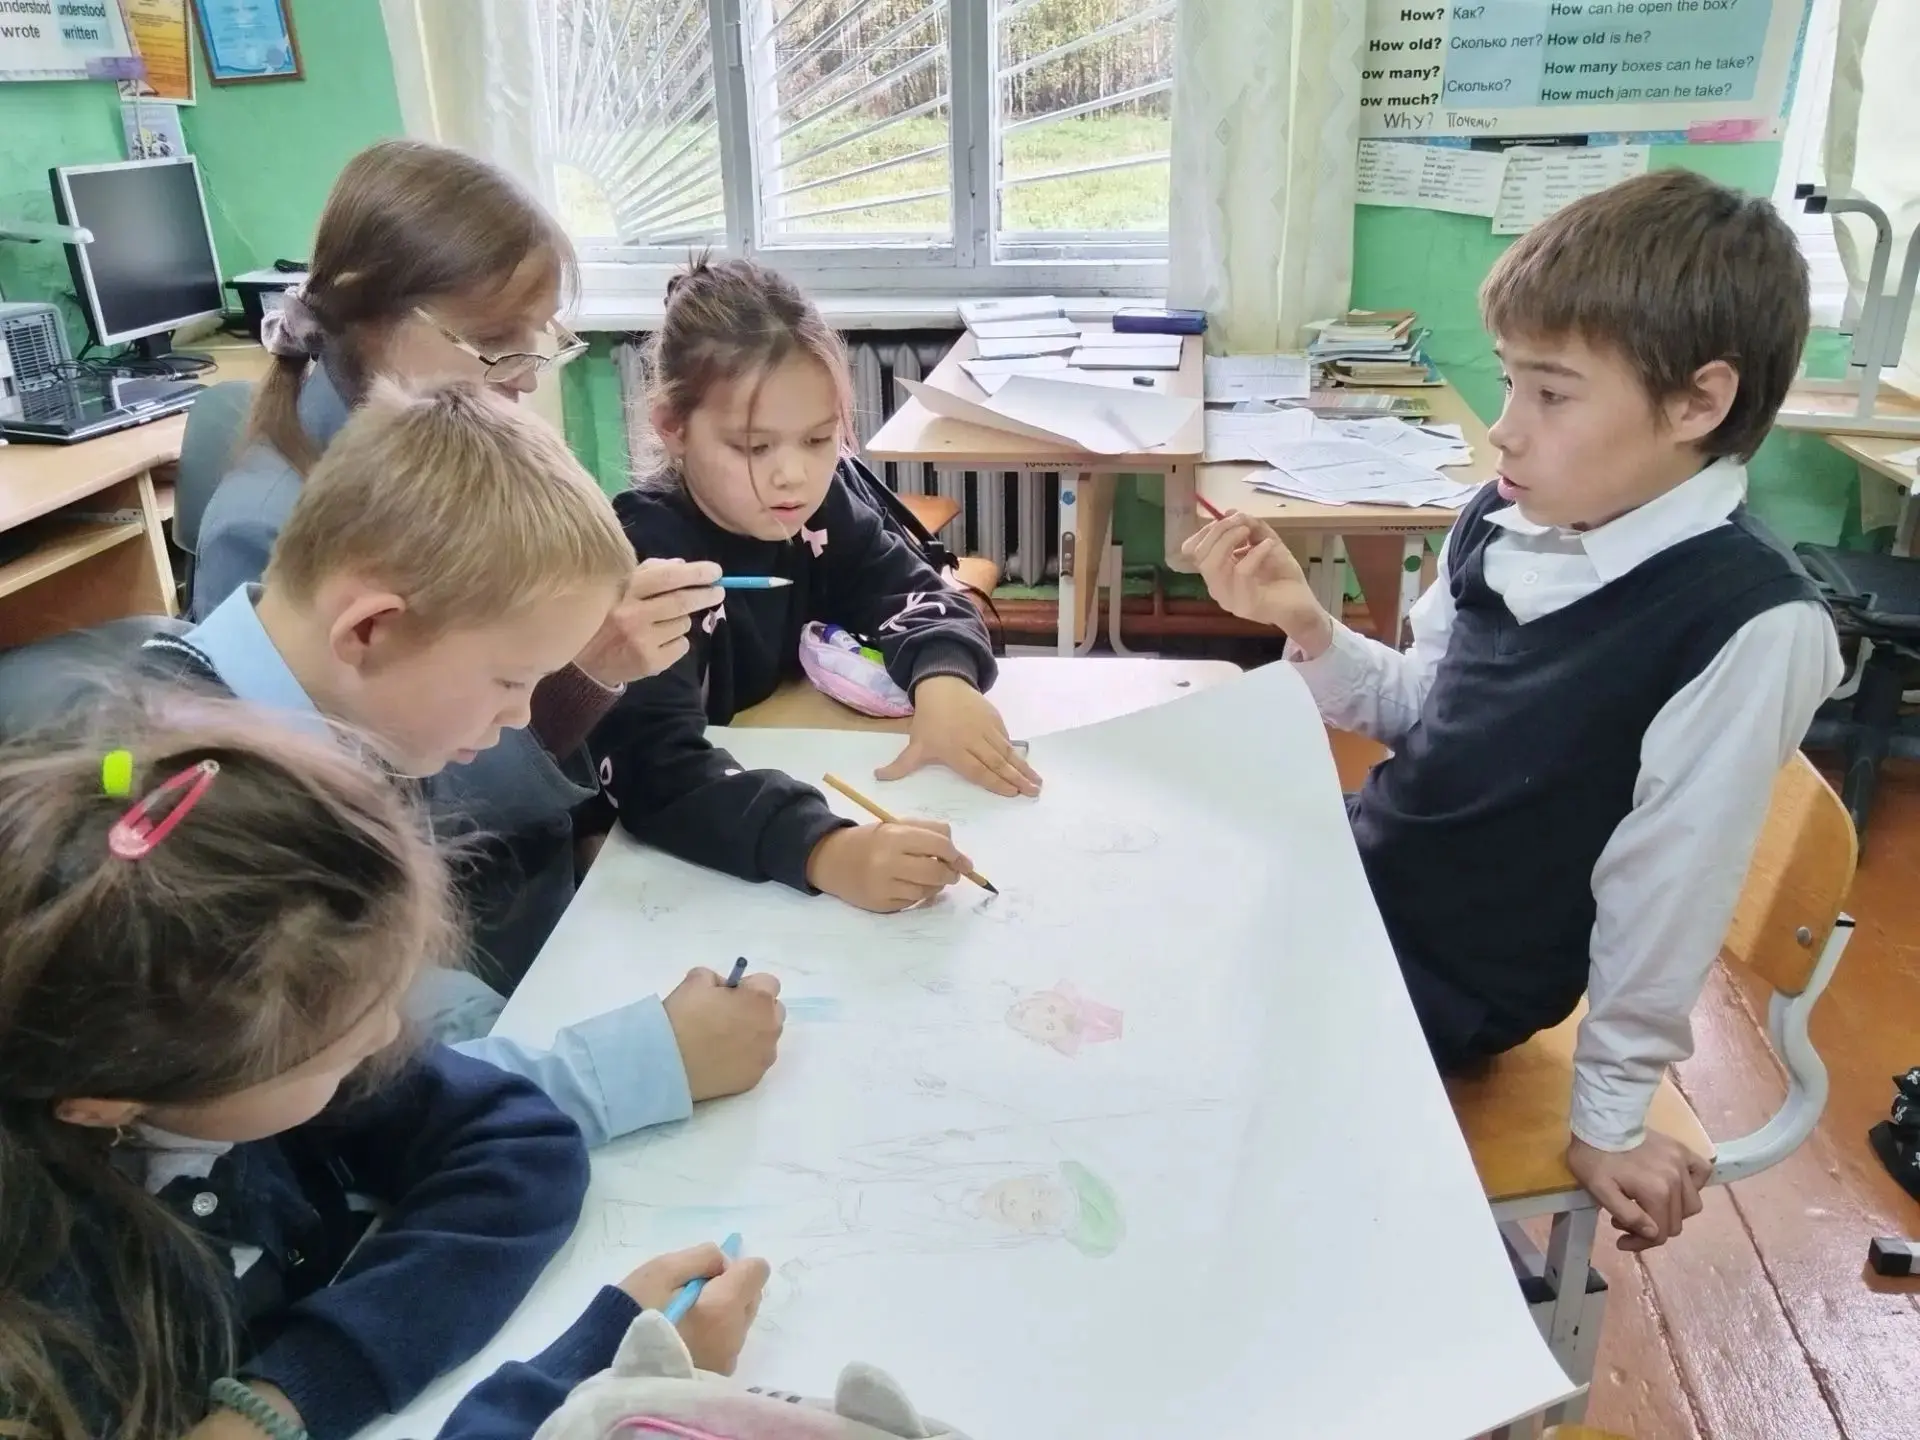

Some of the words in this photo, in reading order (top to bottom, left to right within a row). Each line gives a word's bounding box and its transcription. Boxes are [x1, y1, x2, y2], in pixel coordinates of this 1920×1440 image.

[57, 2, 106, 17] understood
[1400, 8, 1445, 21] How?
[1453, 6, 1485, 20] Как?
[1551, 3, 1583, 15] How
[1588, 4, 1612, 15] can
[1618, 1, 1634, 13] he
[1639, 2, 1673, 15] open
[1678, 0, 1698, 12] the
[1703, 0, 1738, 11] box?
[0, 24, 41, 38] wrote
[62, 25, 99, 40] written
[1547, 33, 1579, 46] How
[1582, 31, 1605, 45] old
[1609, 32, 1621, 44] is
[1625, 30, 1652, 43] he?
[1369, 39, 1404, 52] How
[1409, 37, 1442, 50] old?
[1450, 36, 1507, 50] Сколько
[1511, 34, 1543, 48] лет?
[1361, 69, 1384, 79] ow
[1389, 65, 1440, 81] many?
[1544, 62, 1574, 74] How
[1579, 61, 1618, 76] many
[1621, 59, 1662, 72] boxes
[1666, 59, 1690, 71] can
[1694, 56, 1712, 70] he
[1716, 55, 1754, 69] take?
[1447, 78, 1512, 92] Сколько?
[1541, 88, 1572, 101] How
[1576, 86, 1614, 100] much
[1616, 86, 1641, 101] jam
[1645, 87, 1670, 99] can
[1674, 85, 1691, 98] he
[1695, 82, 1732, 97] take?
[1360, 97, 1382, 107] ow
[1387, 93, 1439, 106] much?
[1383, 111, 1434, 130] Why?
